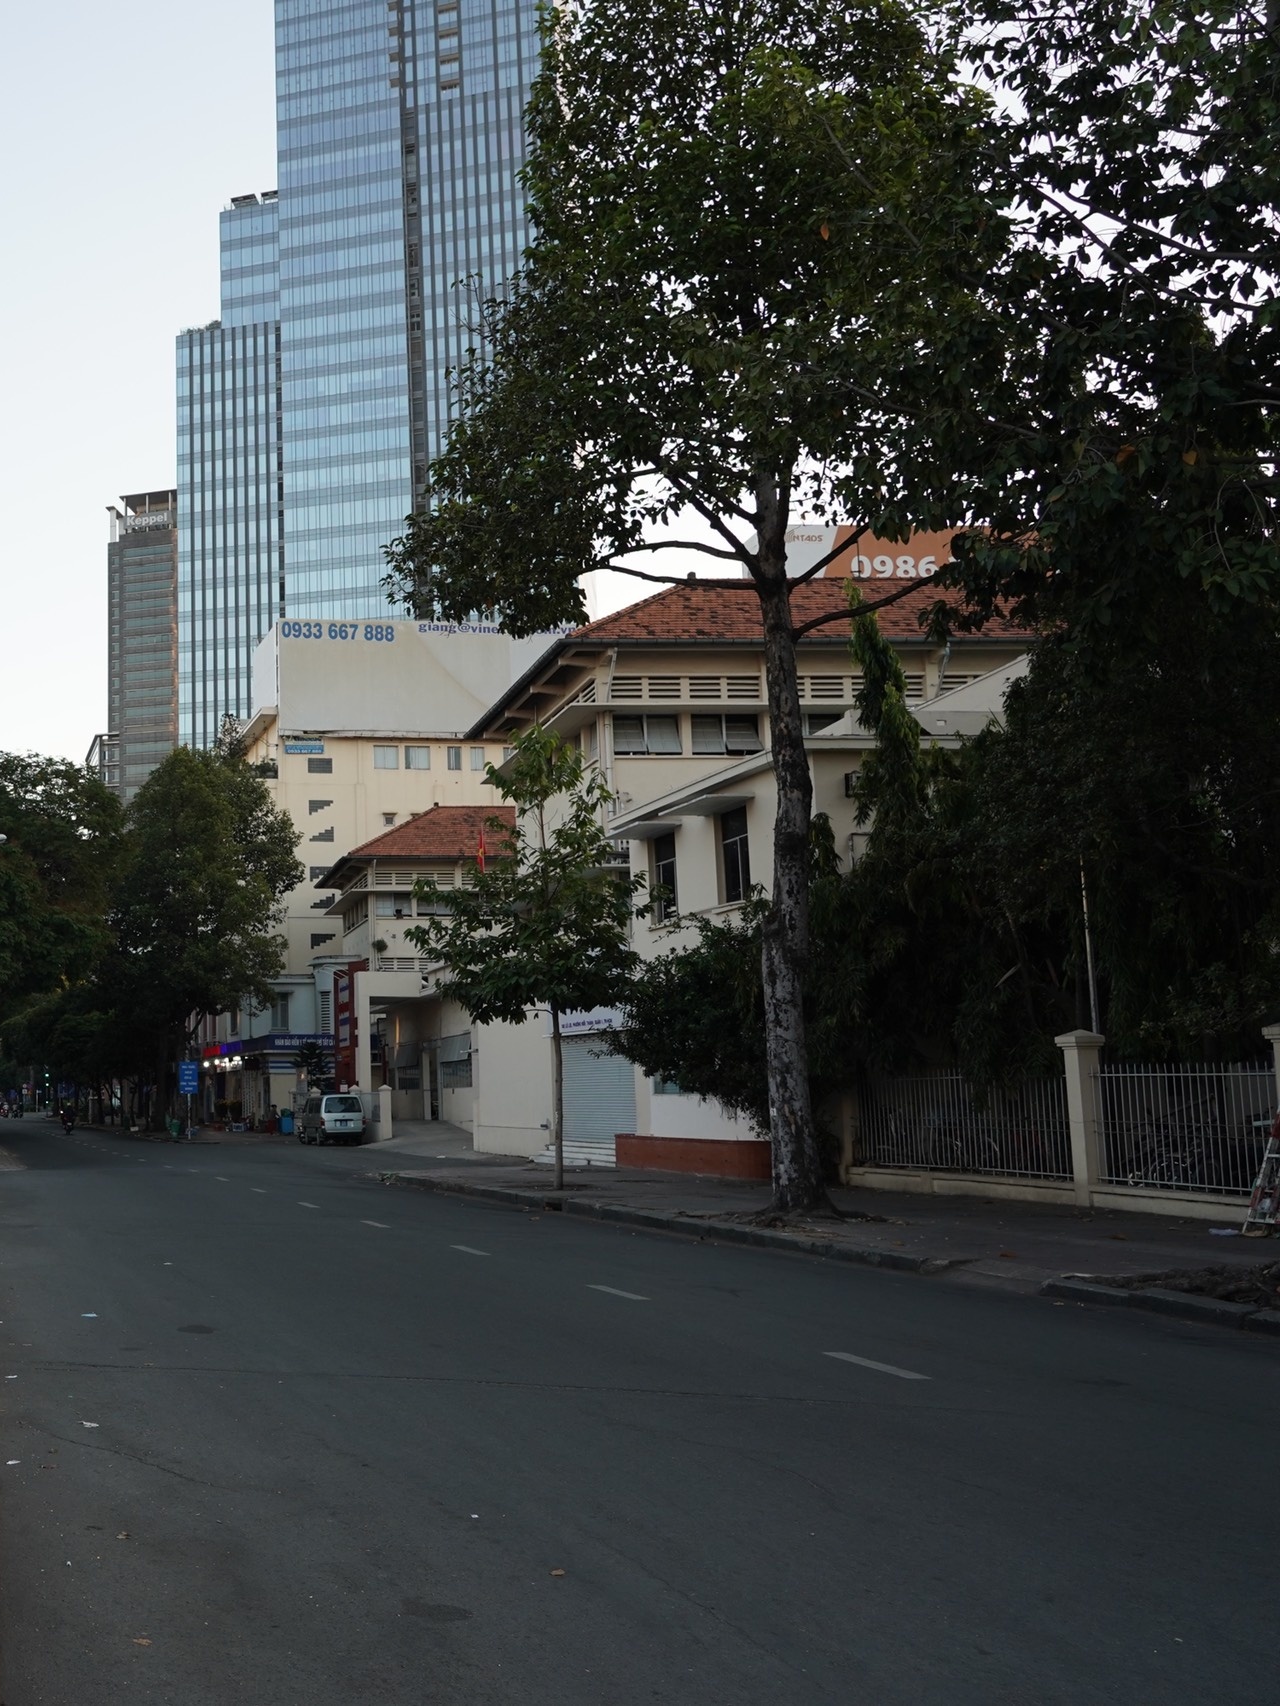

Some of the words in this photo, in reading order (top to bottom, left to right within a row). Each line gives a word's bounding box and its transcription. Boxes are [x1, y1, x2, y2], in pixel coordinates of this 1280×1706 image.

[126, 512, 168, 526] Keppel
[850, 555, 938, 578] 0986
[281, 621, 323, 639] 0933
[328, 623, 359, 640] 667
[364, 624, 395, 642] 888
